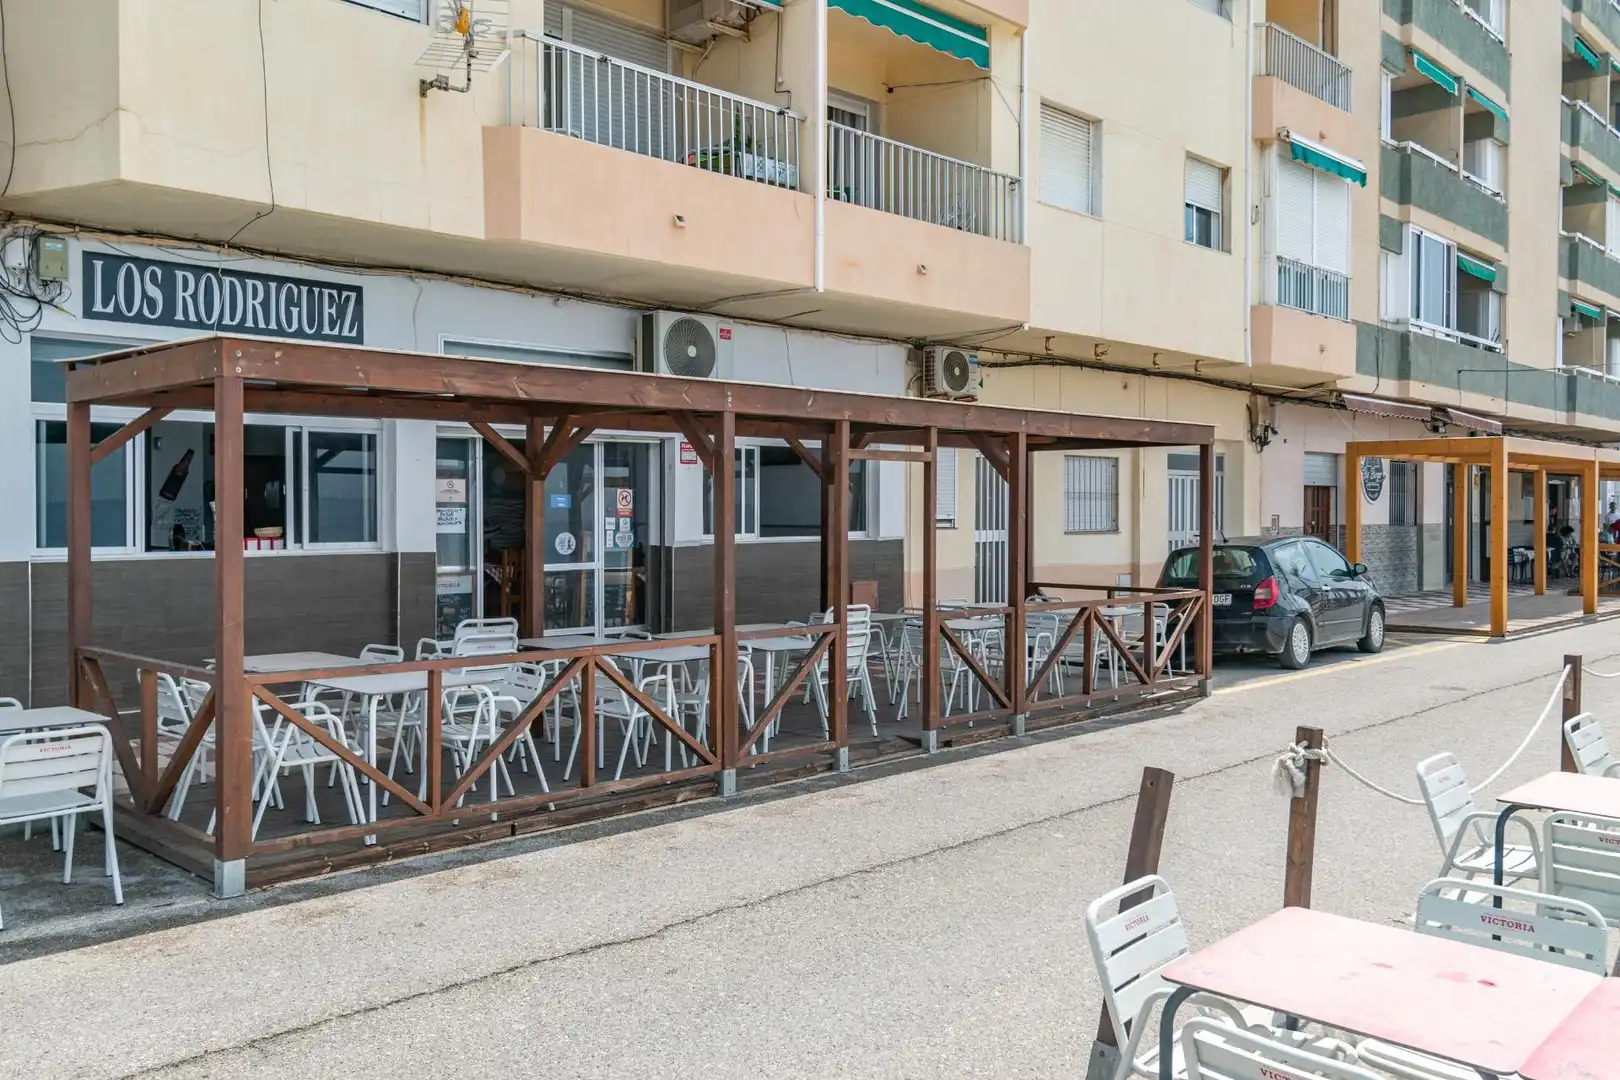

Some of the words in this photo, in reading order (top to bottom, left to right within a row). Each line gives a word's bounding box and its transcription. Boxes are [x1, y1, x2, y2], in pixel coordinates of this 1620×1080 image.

[92, 260, 164, 320] LOS
[174, 269, 359, 338] RODRIGUEZ
[40, 745, 72, 753] VICTORIA
[1598, 836, 1620, 845] VICT
[1480, 915, 1536, 933] VICTORIA
[1260, 1067, 1291, 1080] VICT
